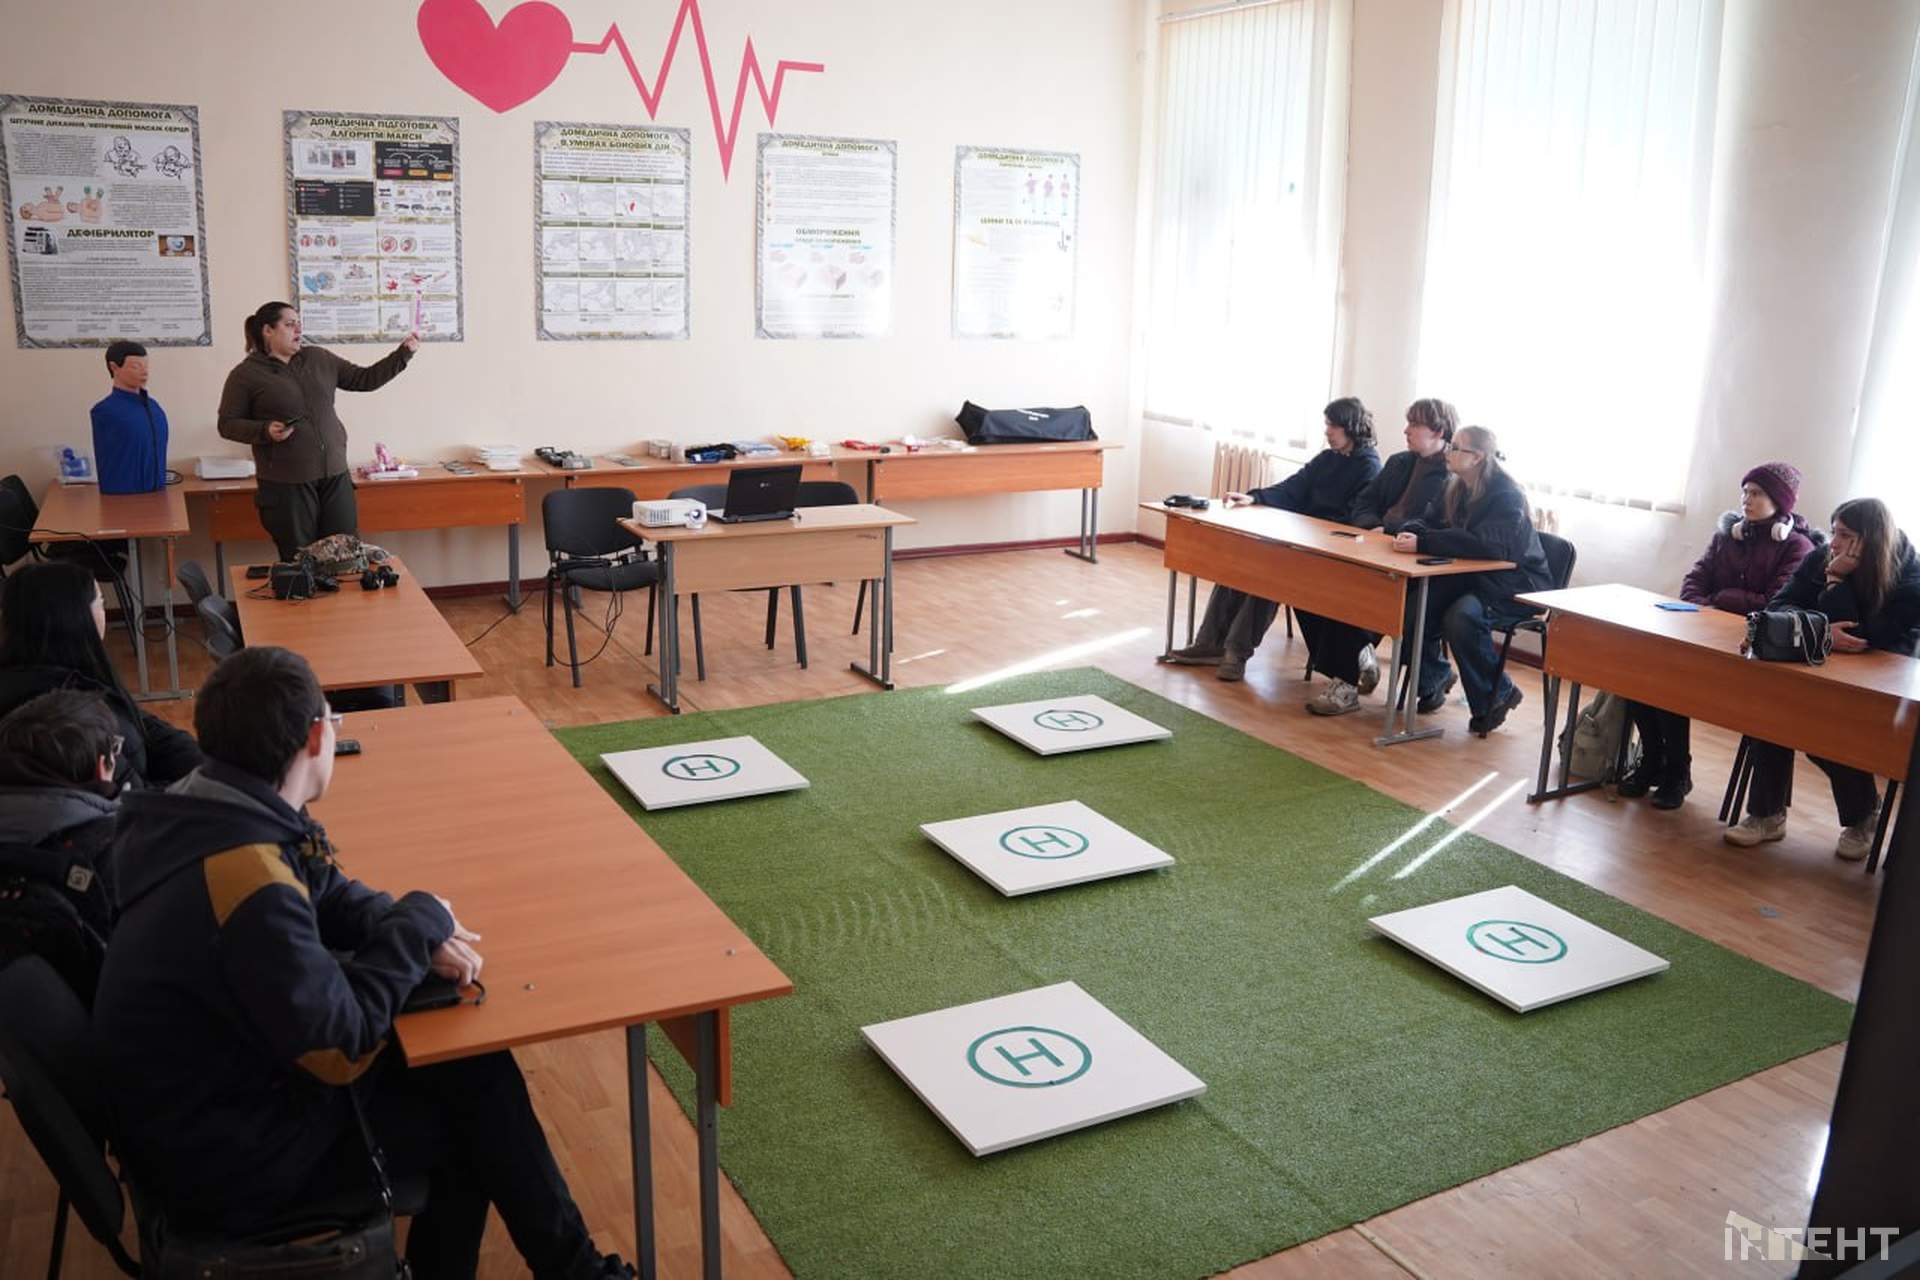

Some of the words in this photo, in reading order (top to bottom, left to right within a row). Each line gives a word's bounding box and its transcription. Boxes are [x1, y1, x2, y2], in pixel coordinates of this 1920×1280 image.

[28, 103, 105, 117] ДОМЕДИЧНА
[107, 108, 172, 120] ДОПОМОГА
[310, 117, 375, 129] ДОМЕДИЧНА
[377, 120, 438, 130] ПІДГОТОВКА
[330, 130, 384, 139] АЛГОРИТМ
[560, 128, 619, 138] ДОМЕДИЧНА
[620, 129, 670, 140] ДОПОМОГА
[569, 139, 607, 148] УМОВАХ
[66, 229, 155, 238] ДЕФІБРИЛЯТОР
